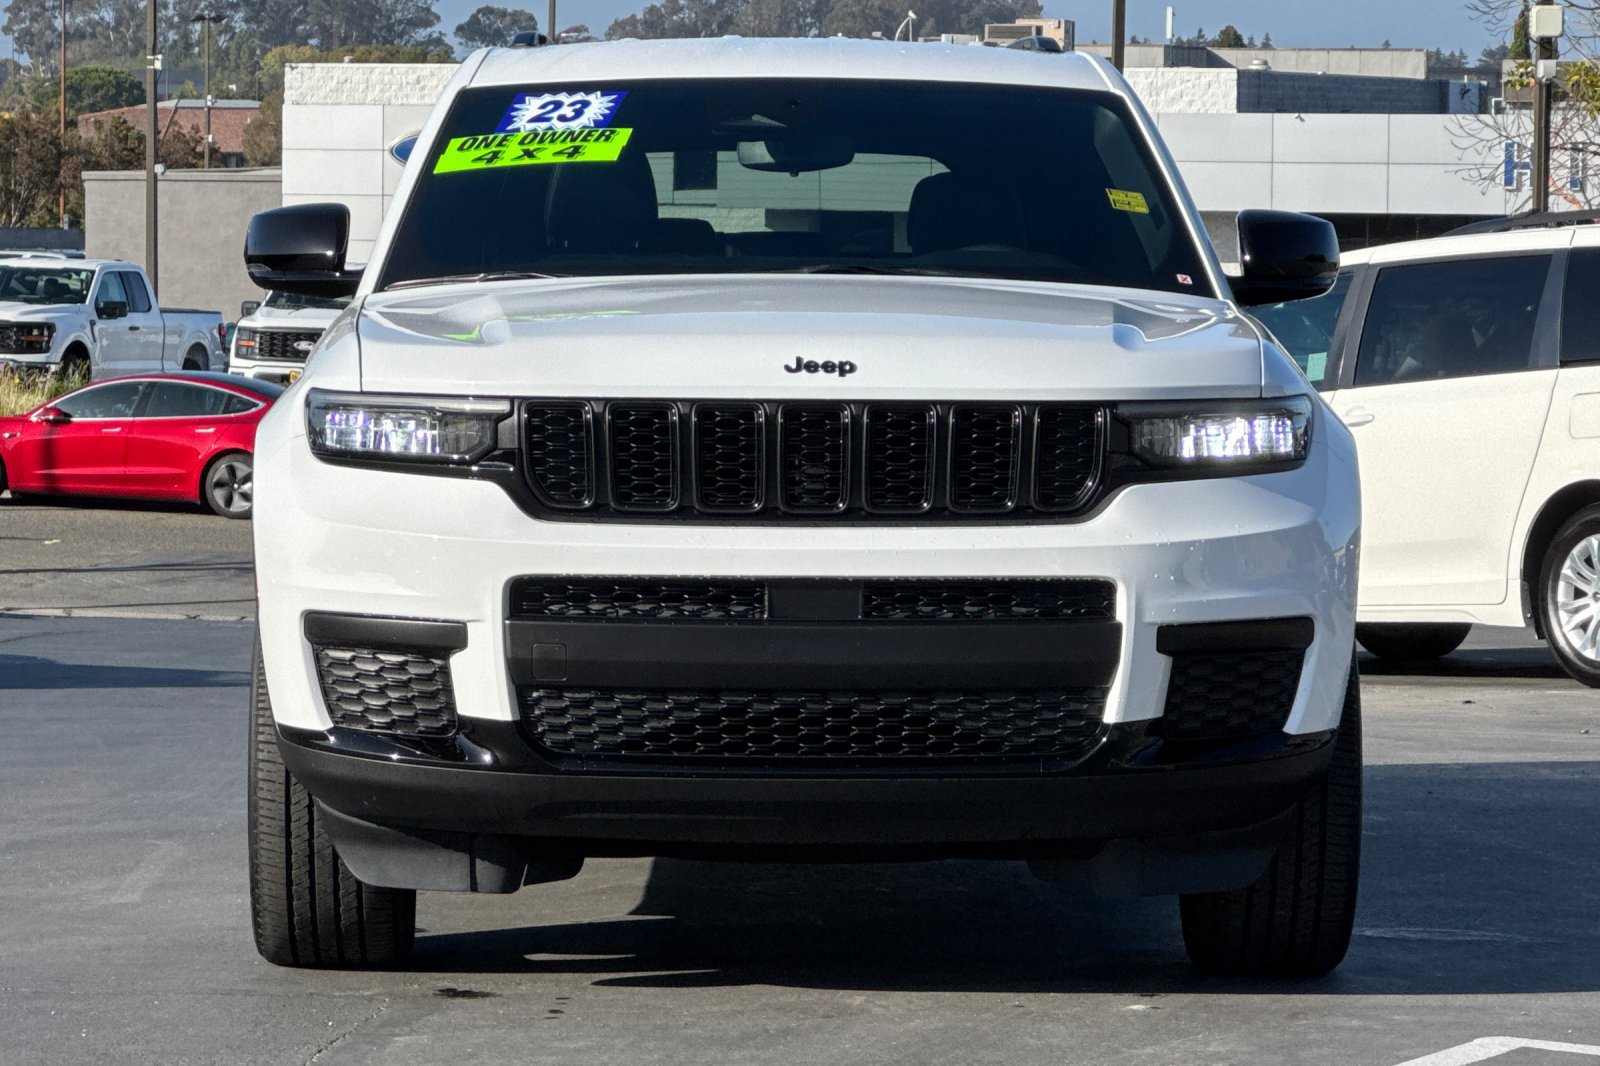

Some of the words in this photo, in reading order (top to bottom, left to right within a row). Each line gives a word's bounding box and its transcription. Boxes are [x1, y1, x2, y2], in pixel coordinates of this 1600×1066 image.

[526, 99, 592, 124] 23
[457, 133, 516, 151] ONE
[518, 128, 620, 147] OWNER
[784, 356, 857, 377] Jeep
